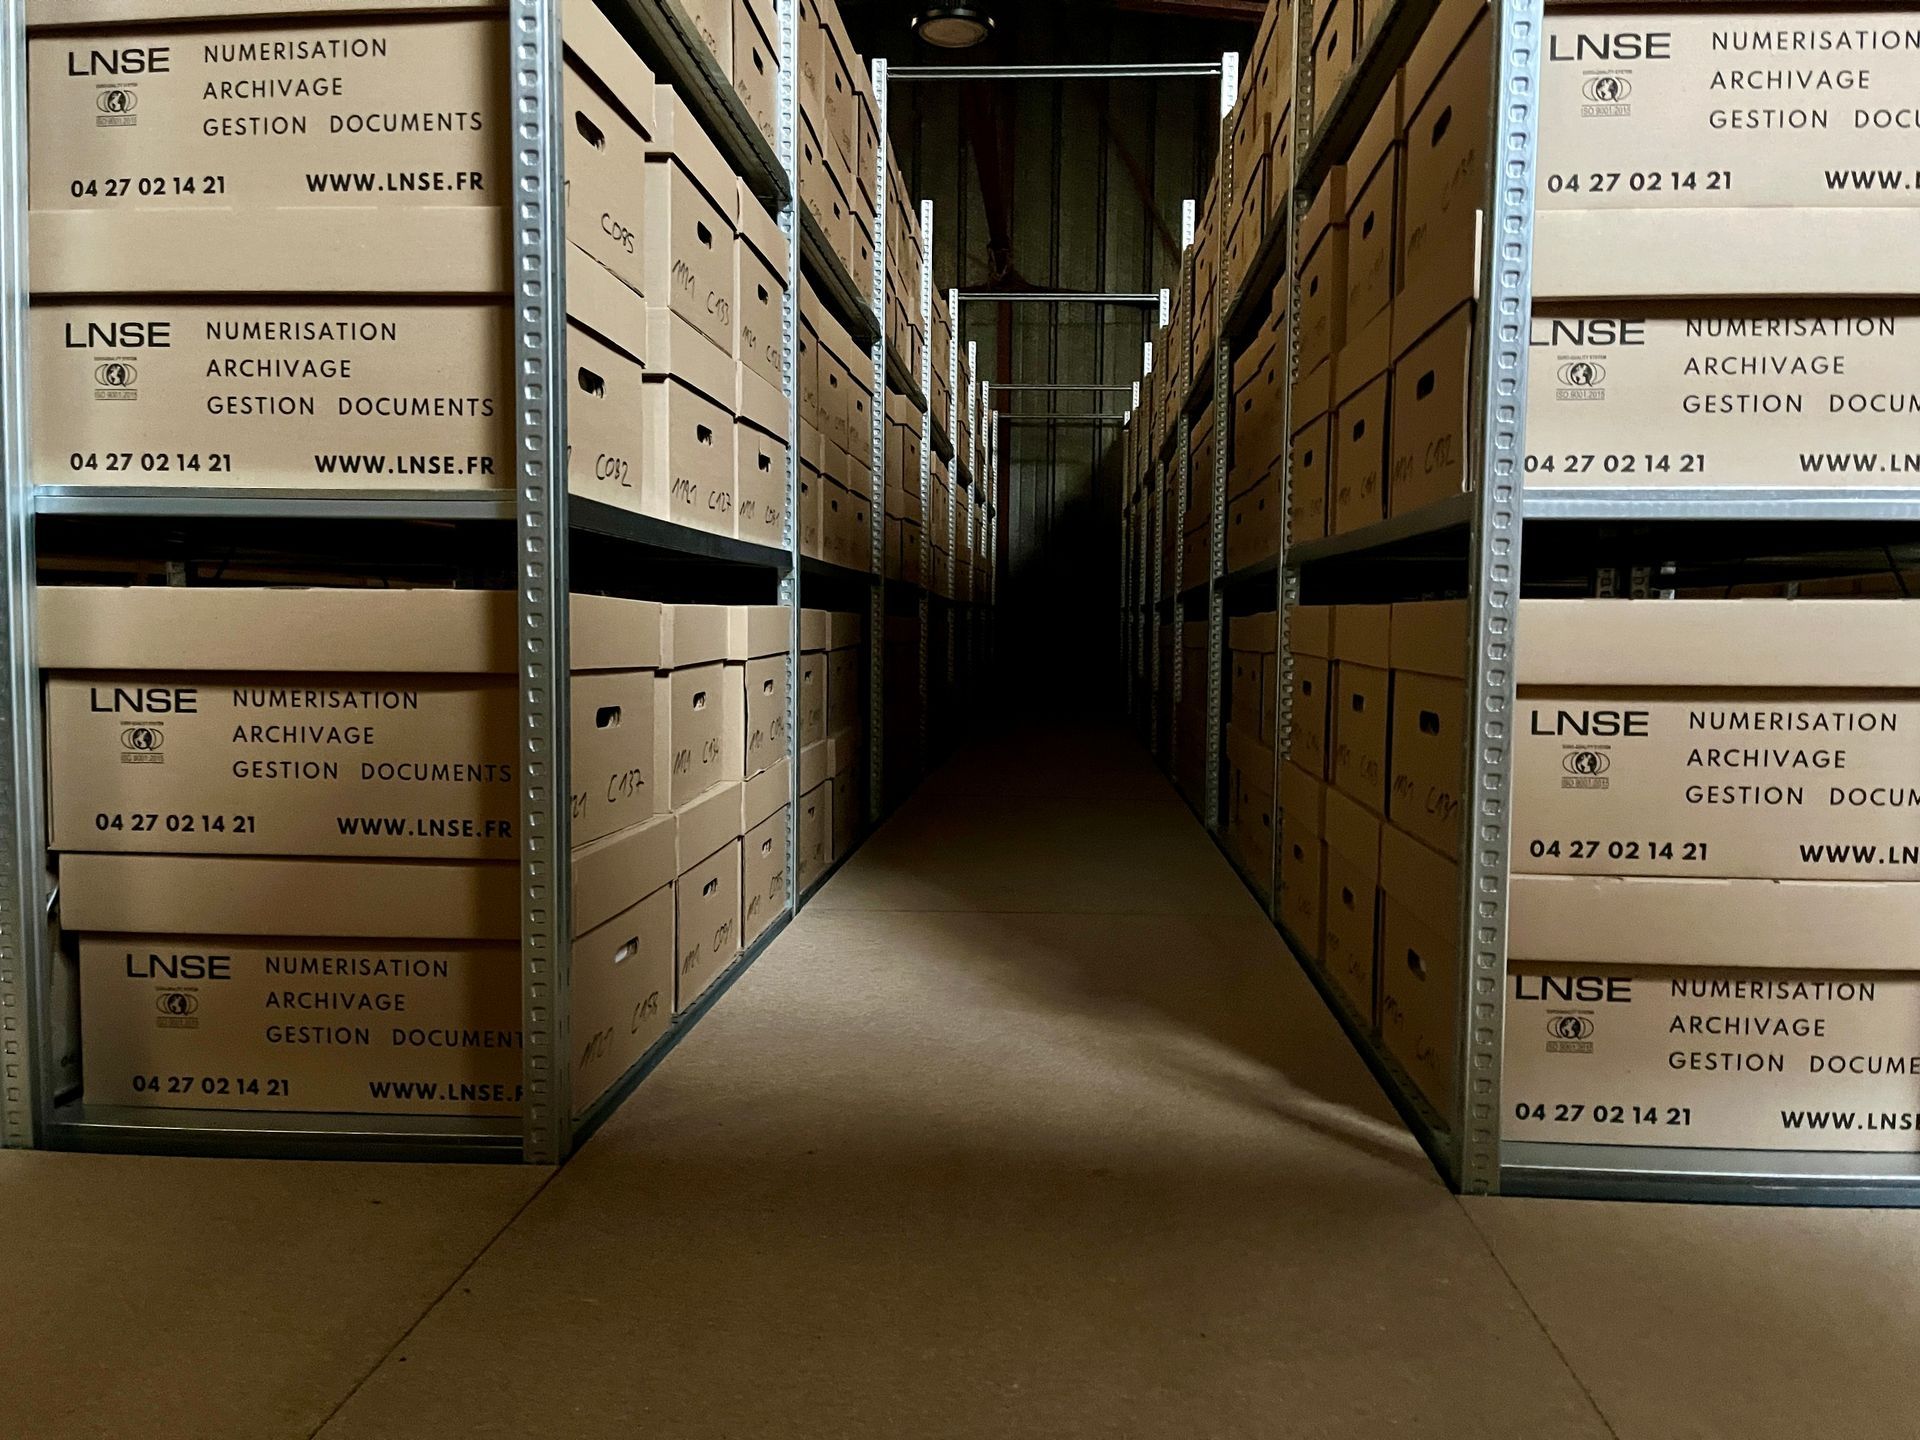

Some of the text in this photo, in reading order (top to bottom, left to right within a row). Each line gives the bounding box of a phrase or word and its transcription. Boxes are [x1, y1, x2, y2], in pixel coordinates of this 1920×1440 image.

[1550, 33, 1670, 60] LNSE
[1713, 31, 1920, 49] NUMERISATION
[205, 39, 385, 62] NUMERISATION
[69, 48, 169, 76] LNSE
[203, 78, 341, 99] ARCHIVAGE
[1711, 71, 1868, 89] ARCHIVAGE
[204, 112, 482, 136] GESTION DOCUMENTS
[1710, 110, 1826, 128] GESTION
[71, 176, 224, 197] 04 27 02 14 21
[306, 172, 484, 192] WWW.LNSE.FR
[1548, 172, 1730, 192] 04 27 02 14 21
[66, 322, 170, 347] LNSE
[207, 322, 395, 340] NUMERISATION
[1529, 319, 1645, 346] LNSE
[1687, 319, 1895, 337] NUMERISATION
[207, 359, 350, 377] ARCHIVAGE
[1684, 357, 1843, 374] ARCHIVAGE
[208, 397, 493, 416] GESTION DOCUMENTS
[1684, 395, 1801, 413] GESTION
[71, 453, 230, 471] 04 27 02 14 21
[315, 456, 495, 474] WWW.LNSE.FR
[1525, 455, 1704, 472] 04 27 02 14 21
[1800, 455, 1920, 471] WWW.LN
[91, 688, 197, 713] LNSE
[233, 689, 419, 710] NUMERISATION
[1532, 711, 1649, 736] LNSE
[1690, 712, 1896, 731] NUMERISATION
[233, 726, 373, 744] ARCHIVAGE
[1687, 749, 1845, 768] ARCHIVAGE
[233, 761, 511, 782] GESTION DOCUMENTS
[1686, 786, 1802, 804] GESTION
[96, 814, 254, 832] 04 27 02 14 21
[337, 818, 512, 837] WWW.LNSE.FR
[1530, 840, 1706, 860] 04 27 02 14 21
[1800, 845, 1918, 864] WWW.LN
[127, 954, 230, 979] LNSE
[266, 957, 447, 977] NUMERISATION
[1516, 975, 1632, 1002] LNSE
[1672, 979, 1875, 1001] NUMERISATION
[266, 992, 404, 1011] ARCHIVAGE
[267, 1026, 368, 1044] GESTION
[1670, 1016, 1824, 1036] ARCHIVAGE
[1669, 1052, 1920, 1074] GESTION DOCUME
[133, 1076, 288, 1096] 04 27 02 14 21
[1516, 1103, 1690, 1125] 04 27 02 14 21
